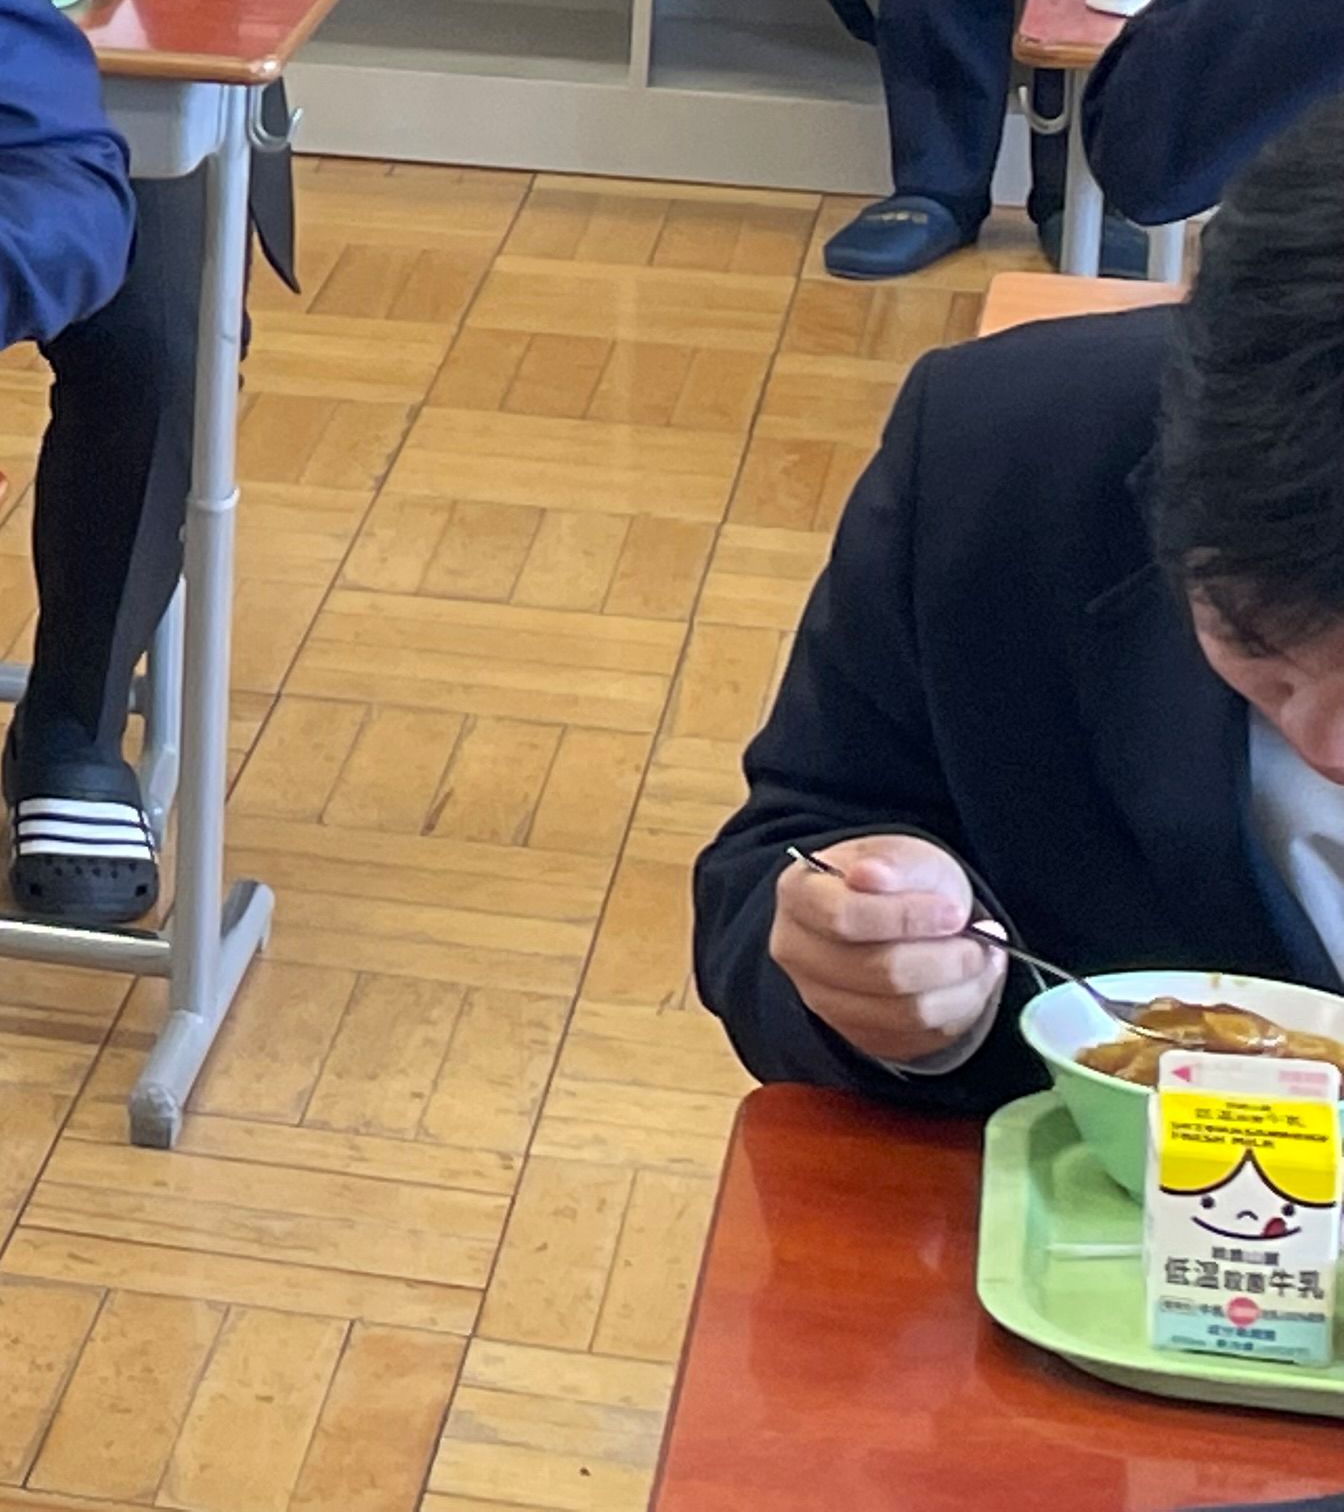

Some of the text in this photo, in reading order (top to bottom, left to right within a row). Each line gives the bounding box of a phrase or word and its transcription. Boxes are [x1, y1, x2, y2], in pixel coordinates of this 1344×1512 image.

[1165, 1256, 1326, 1300] 低温殺菌牛乳
